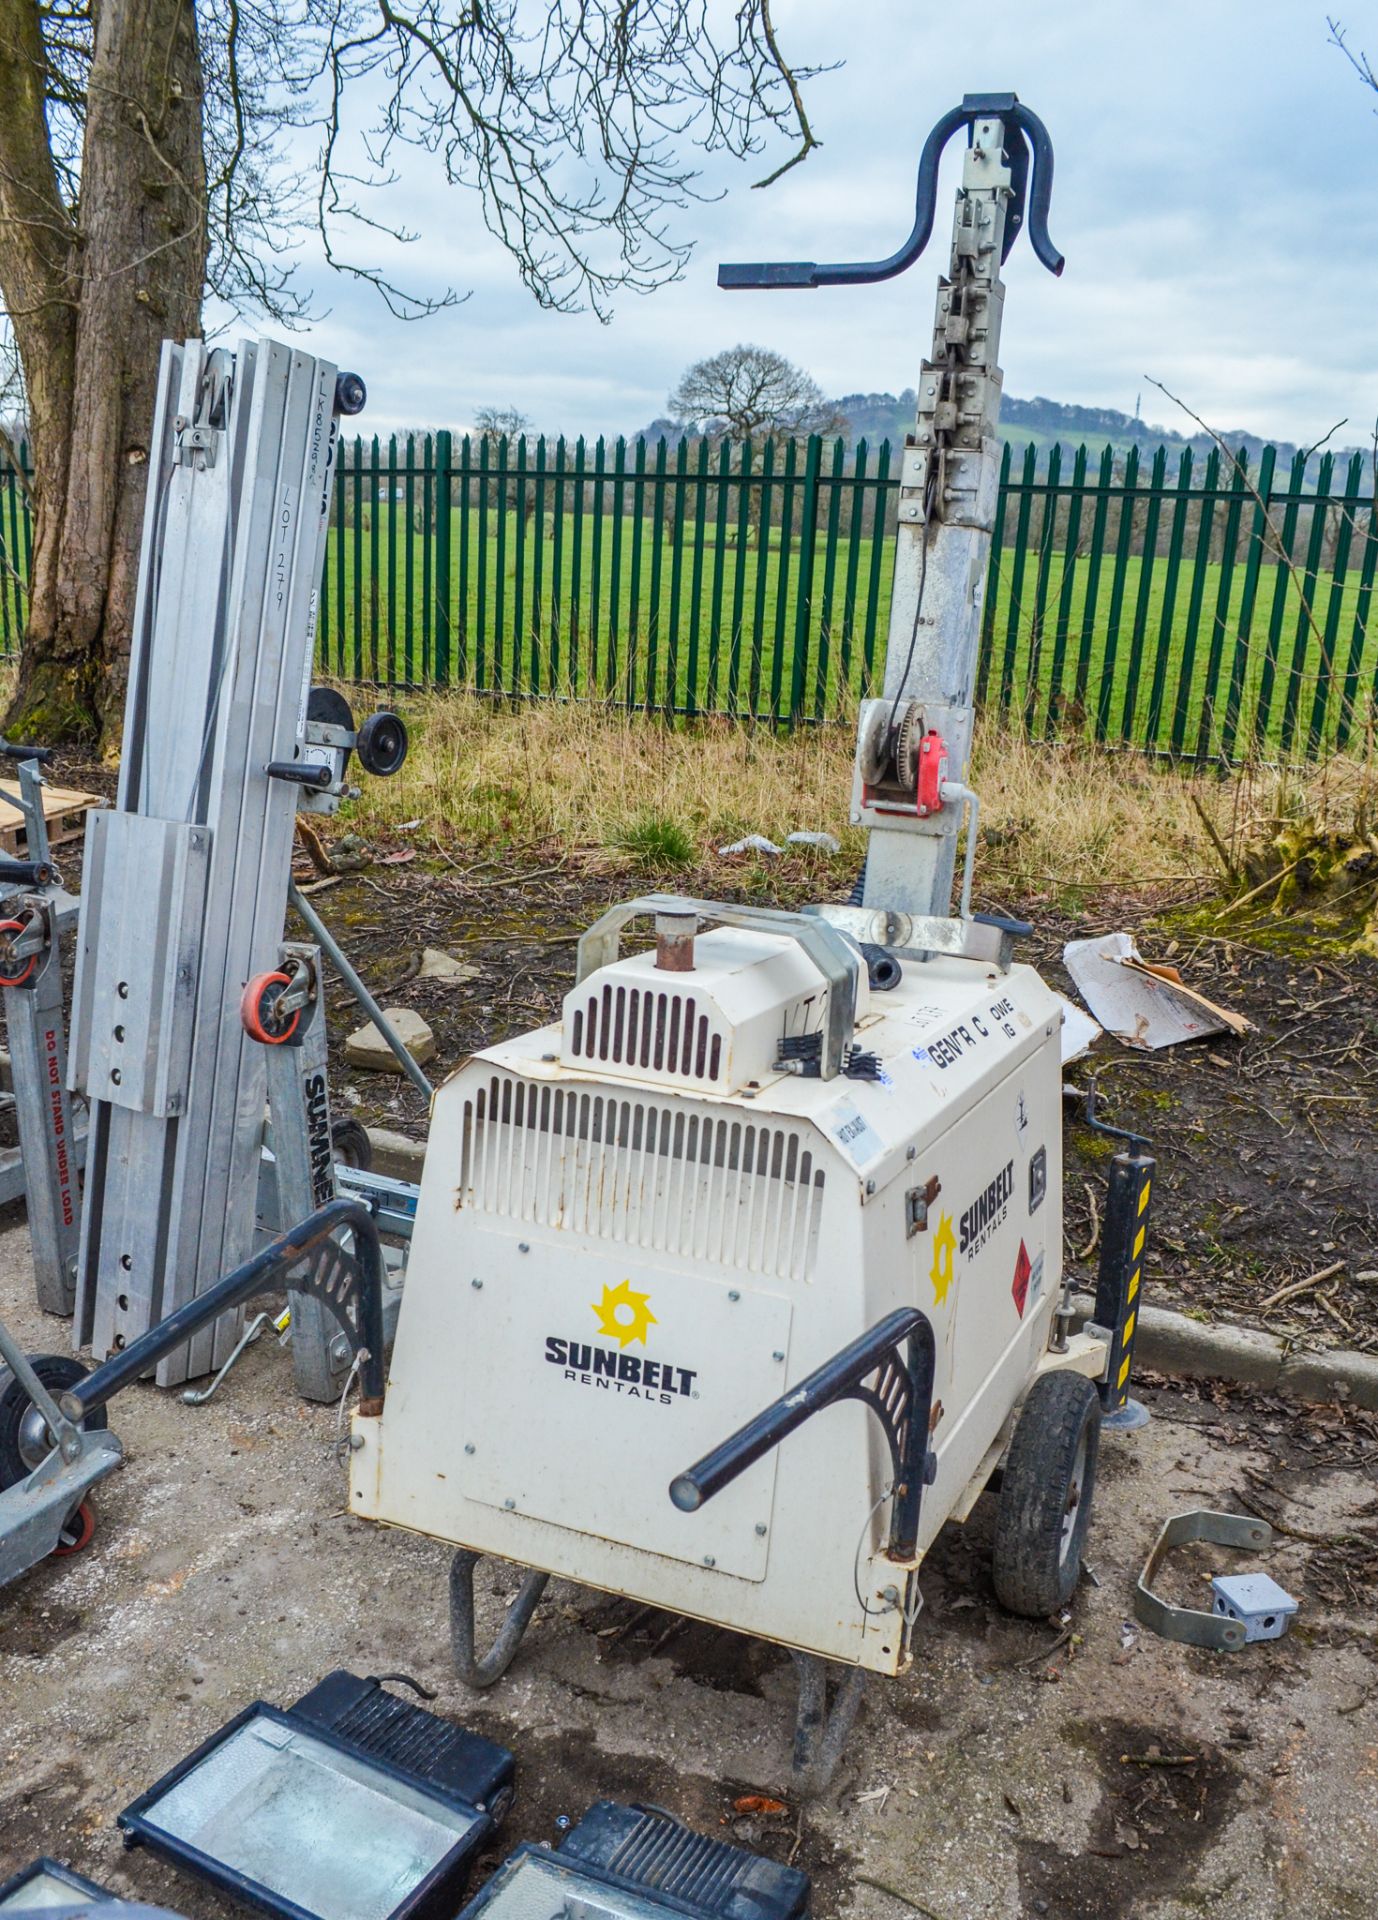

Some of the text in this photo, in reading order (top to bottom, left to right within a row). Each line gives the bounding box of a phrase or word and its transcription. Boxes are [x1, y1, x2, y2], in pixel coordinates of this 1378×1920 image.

[276, 487, 291, 612] LOT 279
[45, 1030, 73, 1226] DO NOT STAND UNDER LOAD
[960, 1158, 1014, 1254] SUNBELT
[968, 1205, 1008, 1263] RENTALS
[545, 1336, 697, 1397] SUNBELT
[564, 1369, 672, 1405] RENTALS
